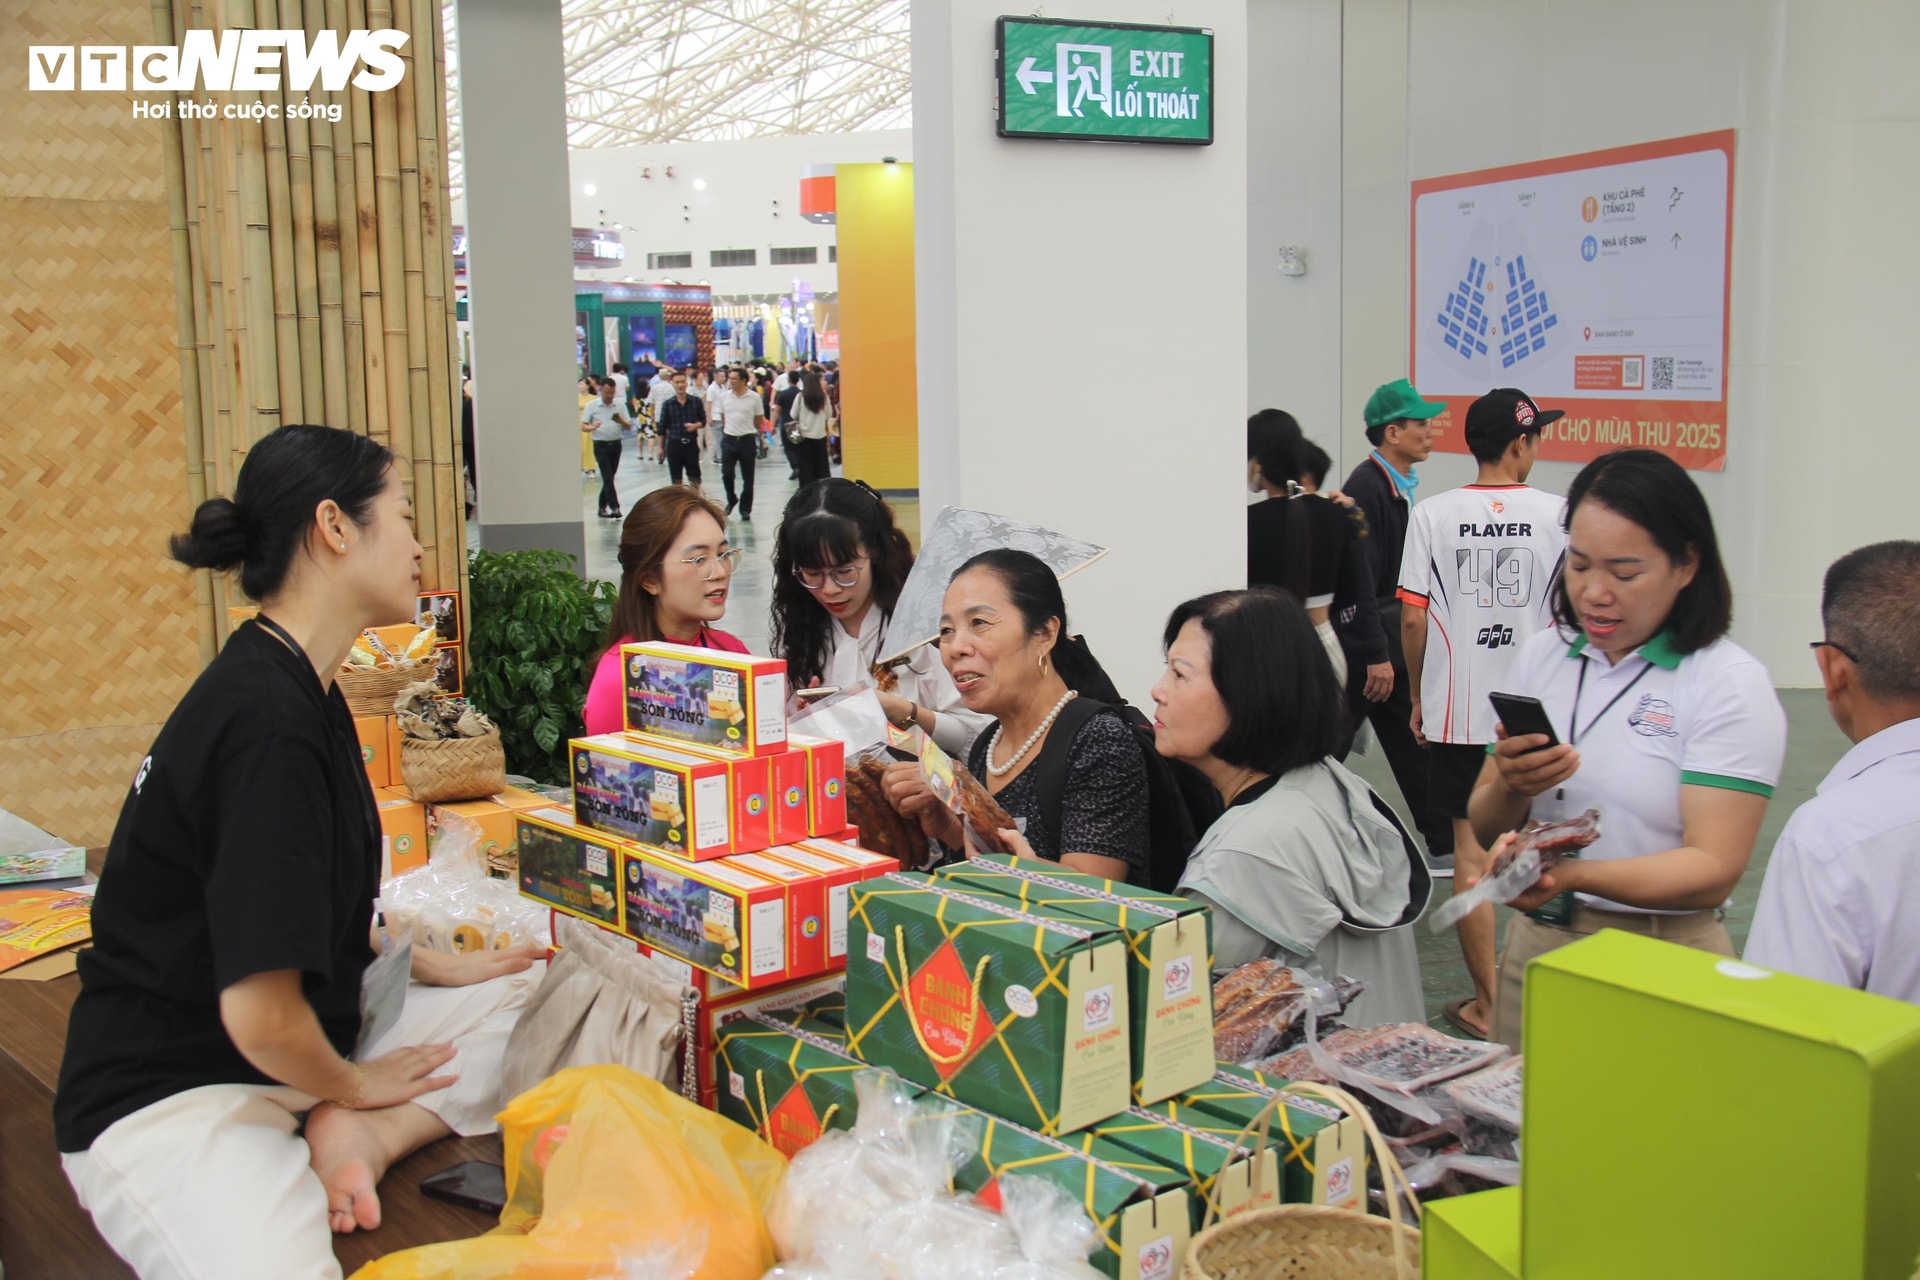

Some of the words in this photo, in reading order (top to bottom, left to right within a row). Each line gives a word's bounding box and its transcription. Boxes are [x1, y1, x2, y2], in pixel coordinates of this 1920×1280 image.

[1130, 49, 1184, 79] EXIT
[1115, 82, 1142, 118] LỐI
[1146, 86, 1200, 120] THOÁT
[1602, 192, 1618, 202] KHU
[1602, 238, 1617, 248] NHÀ
[1629, 235, 1647, 245] SINH
[1558, 417, 1592, 445] CHỢ
[1595, 416, 1633, 445] MÙA
[1637, 421, 1671, 447] THU
[1676, 422, 1721, 449] 2025
[1459, 523, 1532, 537] PLAYER
[1456, 547, 1534, 608] 49
[1477, 624, 1513, 649] FPT
[714, 671, 738, 685] OCOP
[655, 772, 678, 787] OCOP
[710, 893, 733, 908] OCOP
[925, 973, 967, 1007] BÁNH
